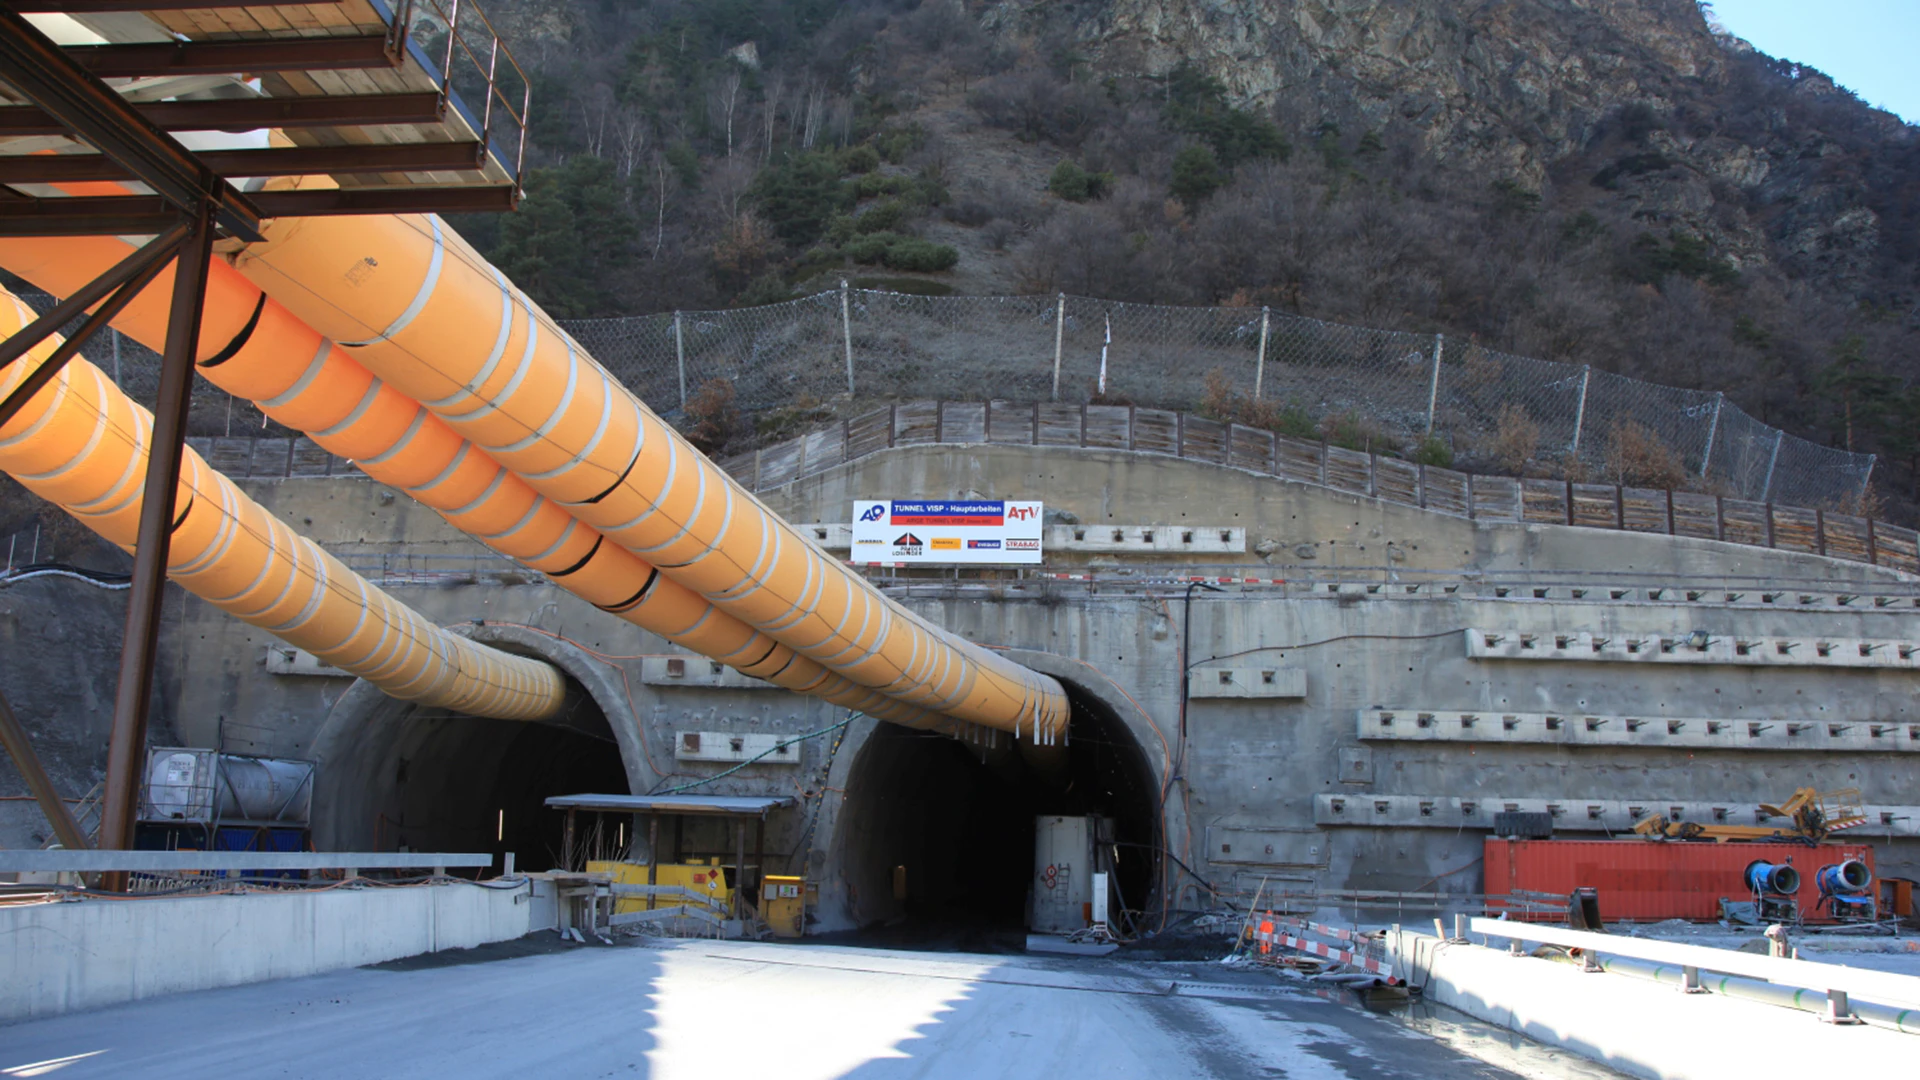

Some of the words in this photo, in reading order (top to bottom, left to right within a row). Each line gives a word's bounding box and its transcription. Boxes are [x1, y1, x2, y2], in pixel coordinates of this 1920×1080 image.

[894, 504, 925, 513] TUNNEL
[926, 504, 944, 513] VISP
[950, 504, 1002, 514] Hauptarbeiten
[1007, 506, 1040, 521] ATV
